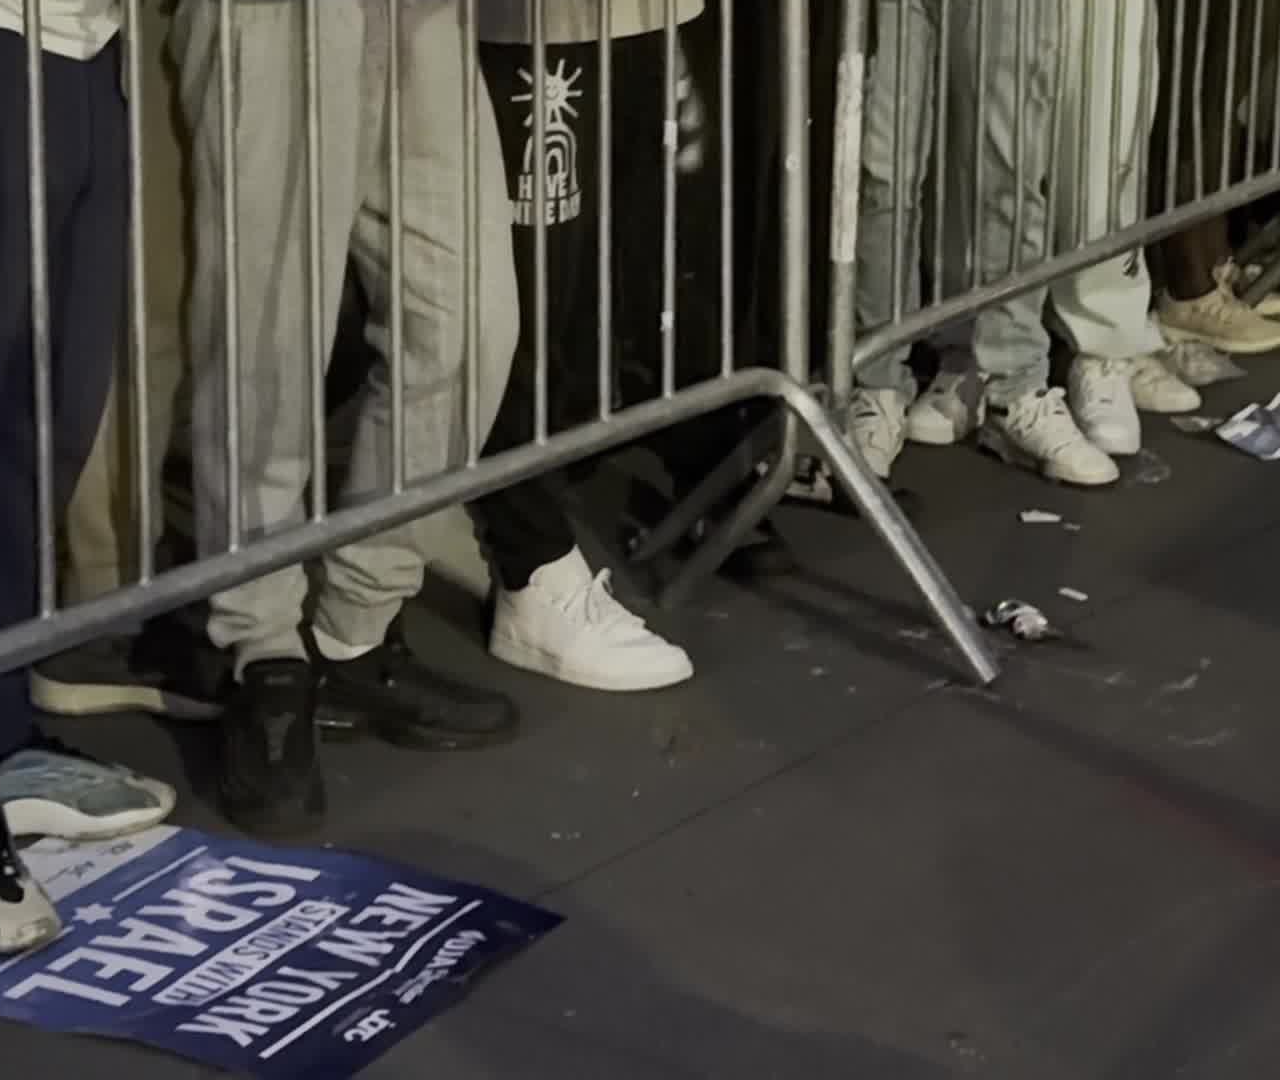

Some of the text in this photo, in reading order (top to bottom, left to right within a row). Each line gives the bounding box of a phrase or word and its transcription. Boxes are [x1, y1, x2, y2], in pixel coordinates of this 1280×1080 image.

[2, 854, 322, 1007] ISRAEL
[162, 902, 338, 1004] STANDS WITH
[316, 881, 459, 968] NEW
[175, 966, 359, 1048] YORK
